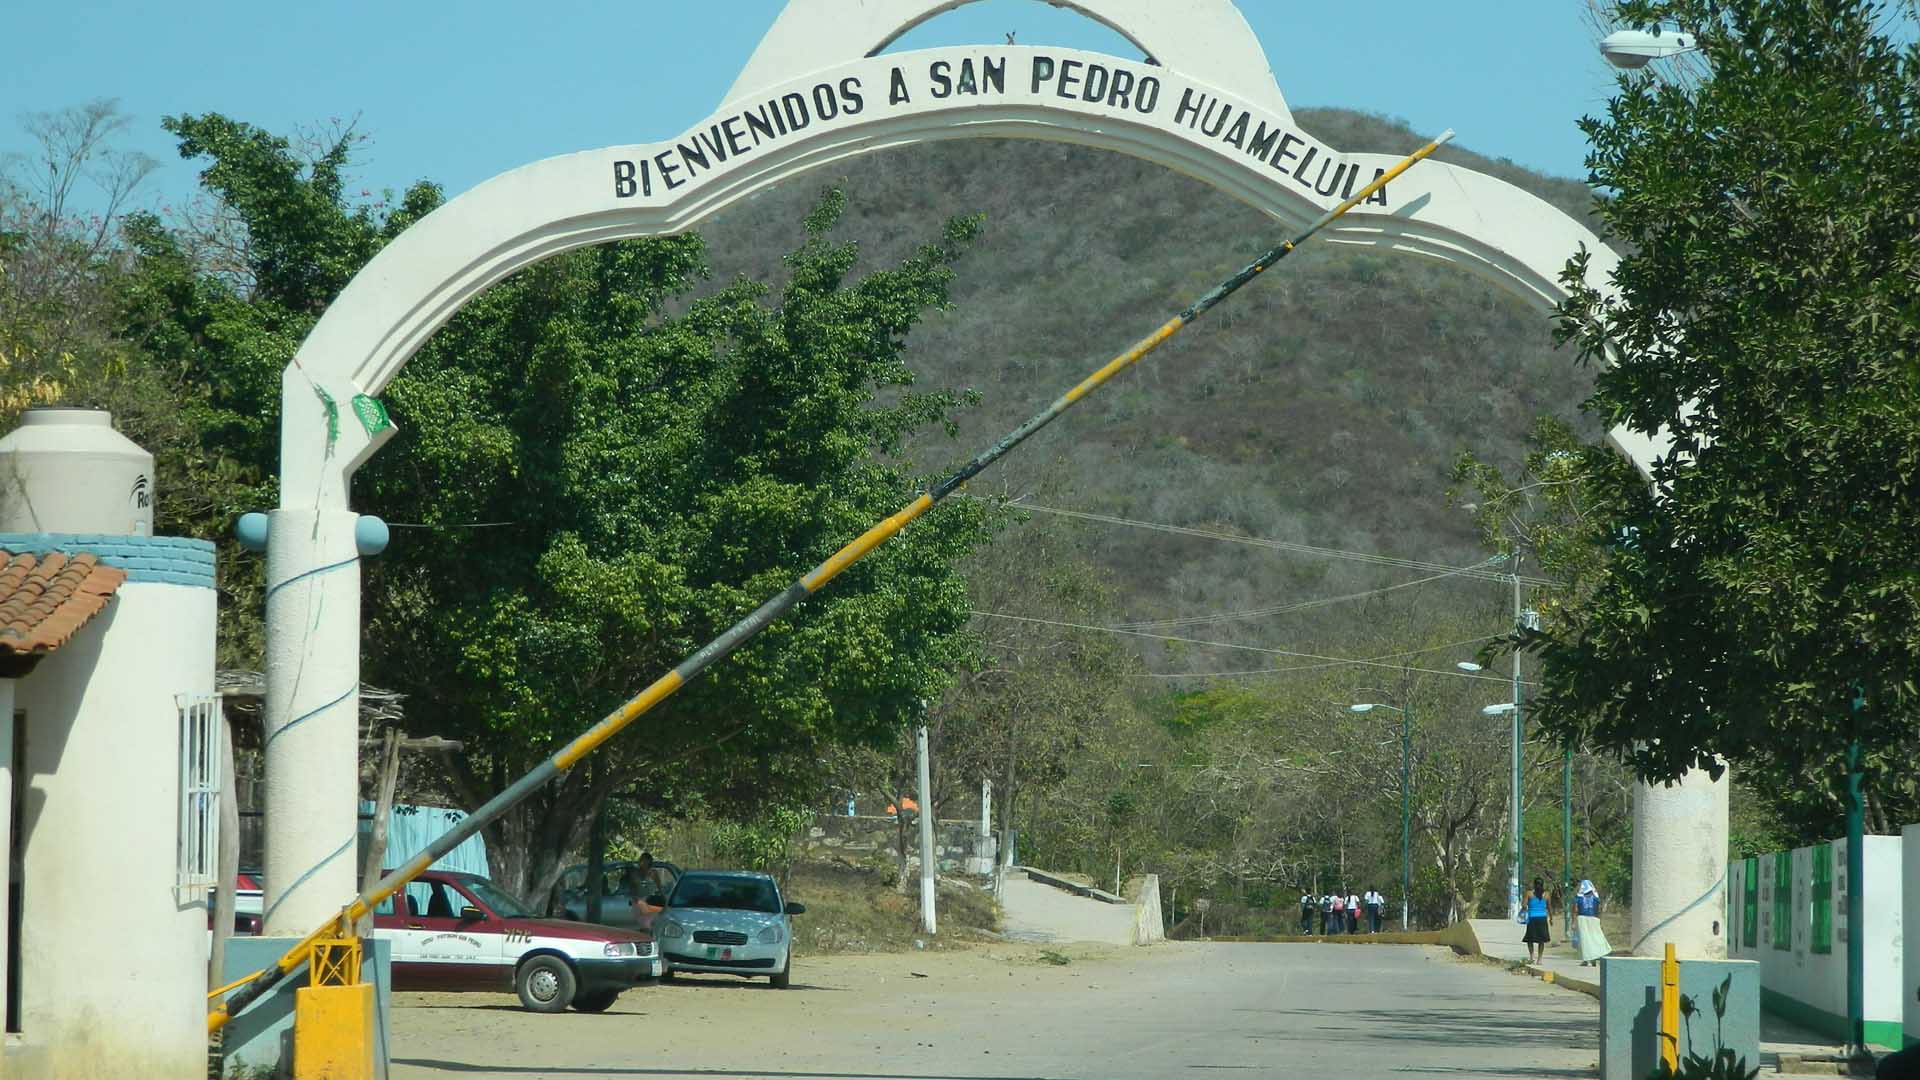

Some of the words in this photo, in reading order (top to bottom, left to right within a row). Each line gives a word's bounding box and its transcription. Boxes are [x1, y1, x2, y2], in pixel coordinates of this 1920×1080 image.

[613, 77, 864, 198] BIENVENIDOS
[888, 67, 911, 106] A
[929, 55, 1006, 99] SAN
[1031, 55, 1161, 114] PEDRO
[1174, 87, 1388, 206] HUAMELULA
